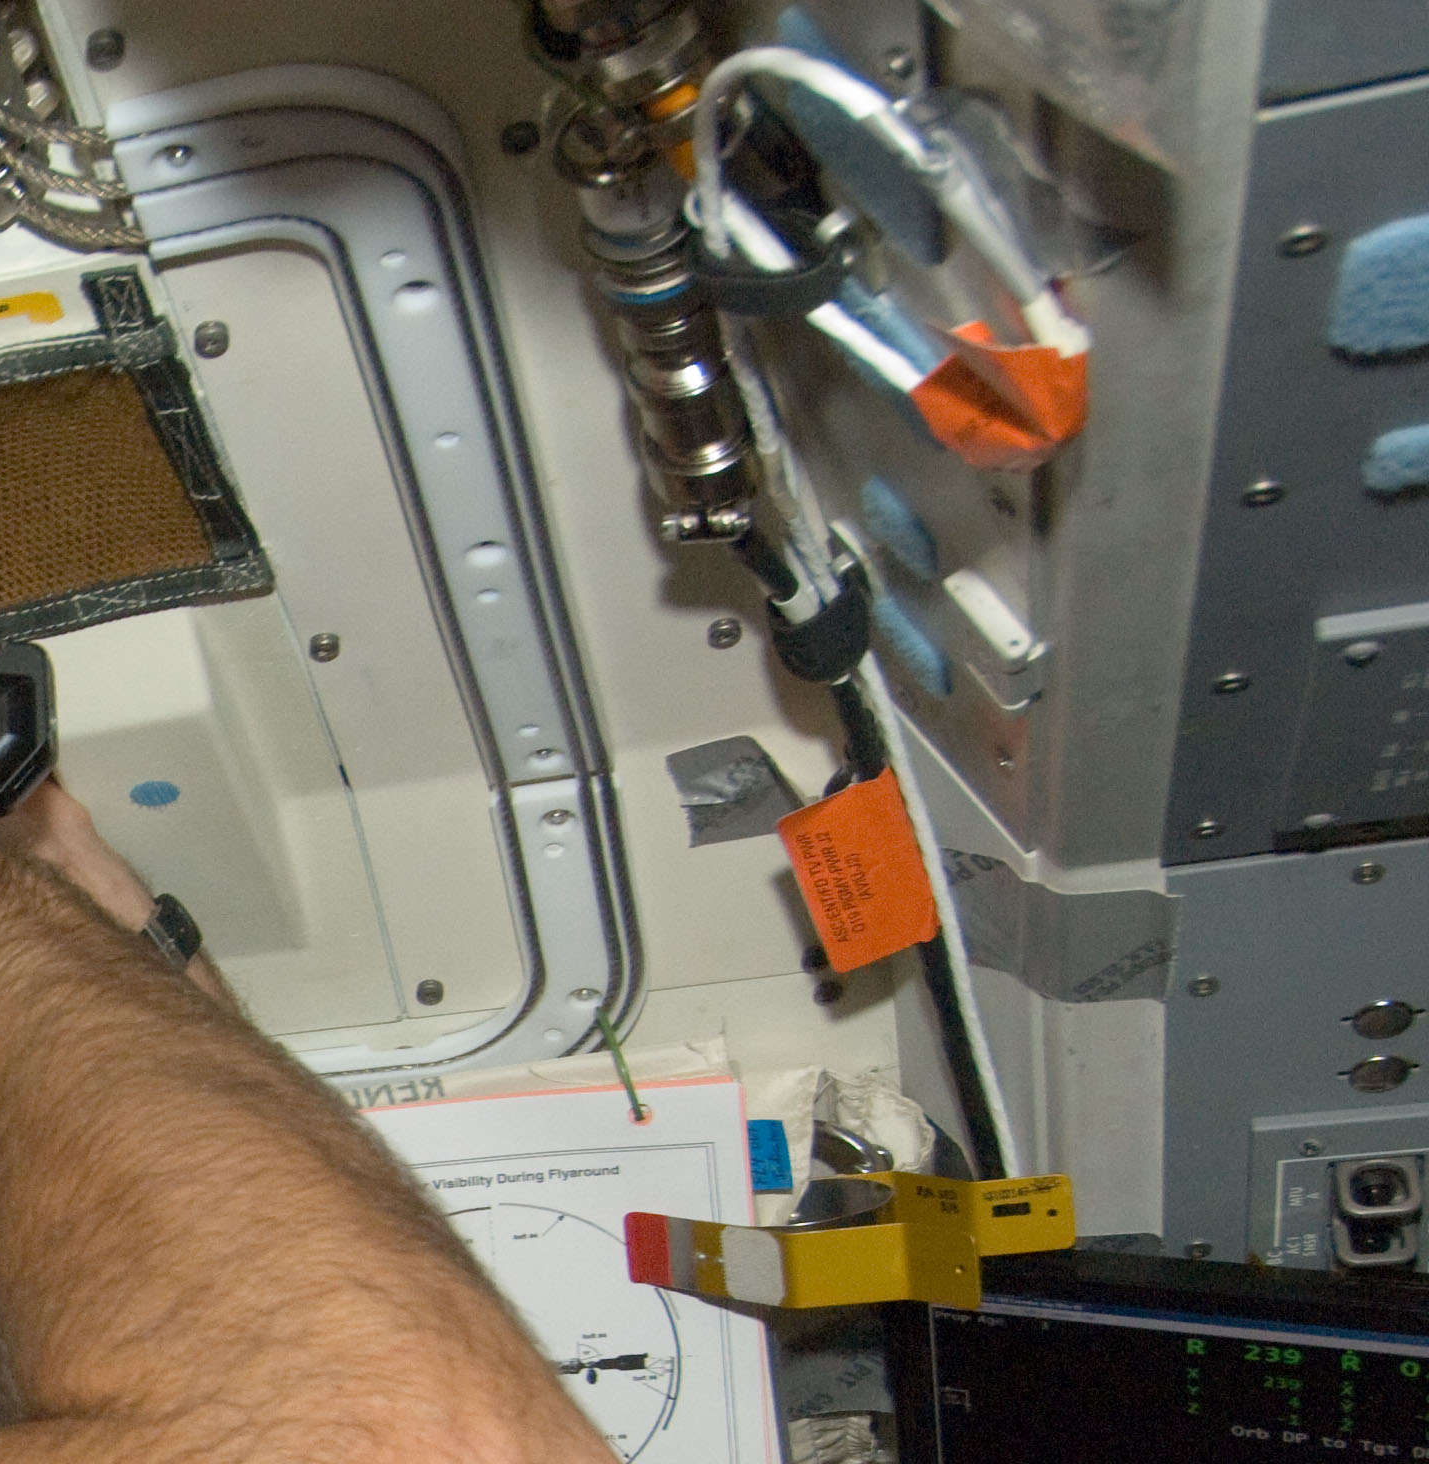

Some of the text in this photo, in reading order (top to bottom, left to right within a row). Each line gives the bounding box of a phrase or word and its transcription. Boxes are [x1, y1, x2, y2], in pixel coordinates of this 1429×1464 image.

[432, 1164, 620, 1191] Visibility During Flyaround
[1187, 1338, 1303, 1366] R 239
[1231, 1425, 1269, 1441] Orb
[1360, 1440, 1399, 1457] Tgt
